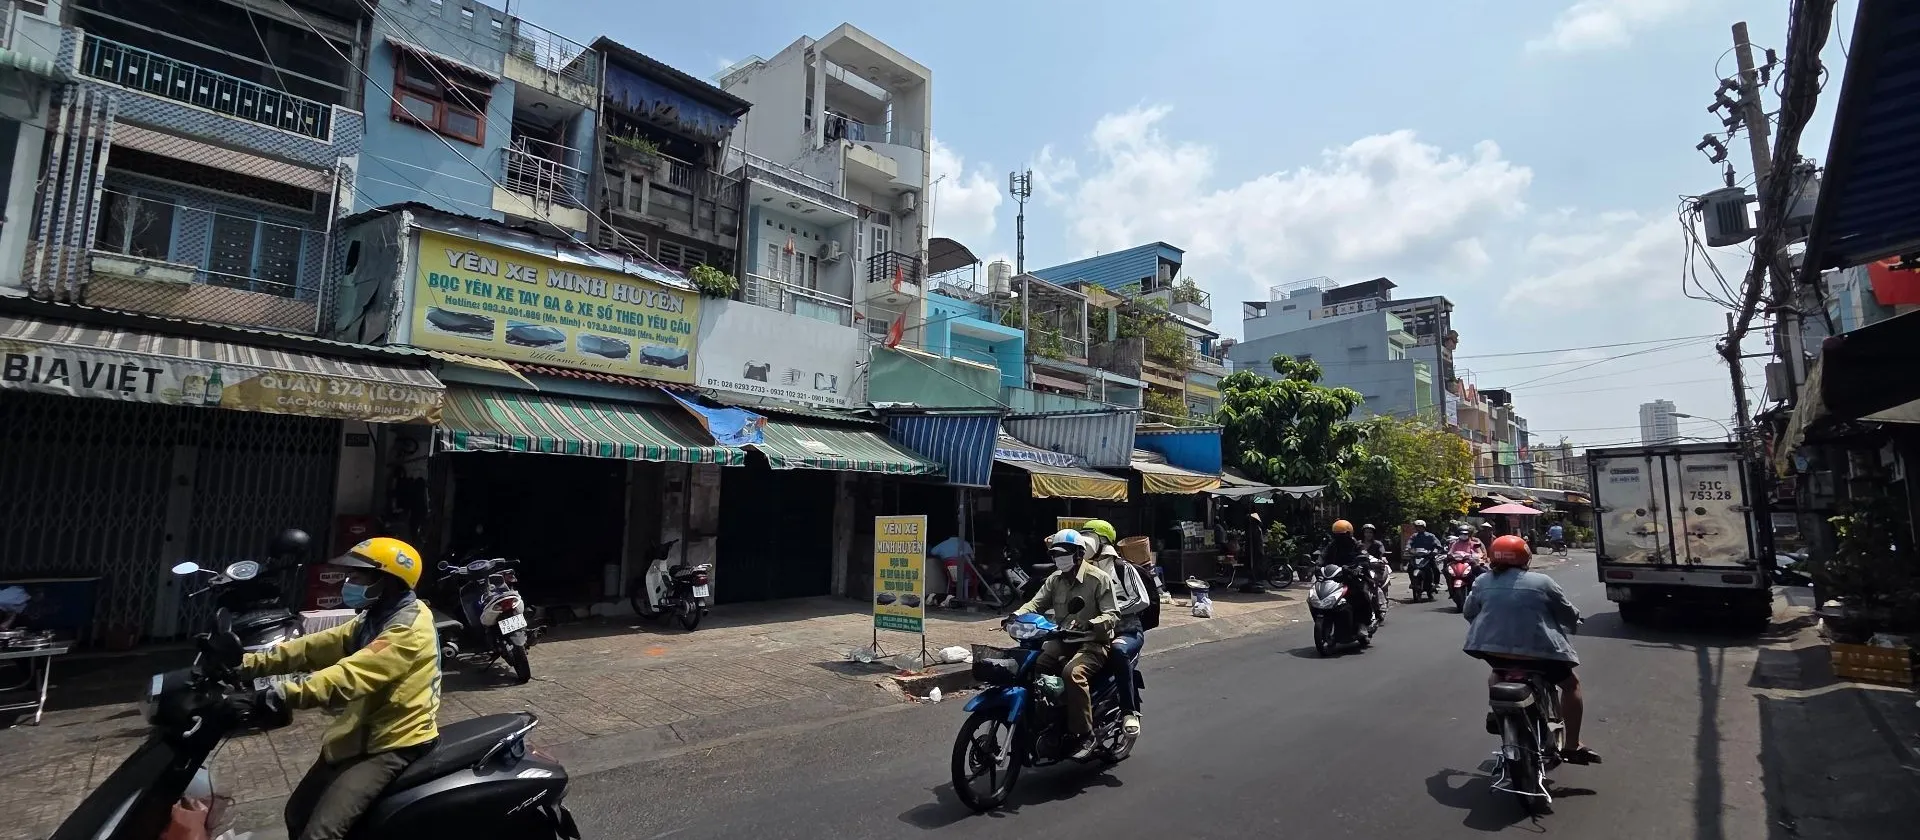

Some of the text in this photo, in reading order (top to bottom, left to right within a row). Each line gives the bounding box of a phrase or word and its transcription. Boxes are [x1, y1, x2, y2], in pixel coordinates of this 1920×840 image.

[445, 249, 498, 276] YÊN
[505, 262, 538, 284] XE
[546, 268, 608, 298] MINH
[428, 272, 460, 293] BỌC
[465, 278, 492, 298] YÊN
[496, 285, 514, 302] XE
[518, 289, 540, 306] TAY
[543, 295, 560, 311] GA
[564, 300, 574, 313] &
[577, 302, 594, 317] XE
[597, 303, 613, 320] SỐ
[616, 309, 644, 326] THEO
[647, 314, 667, 331] YÊU
[445, 295, 480, 309] Hotline:
[560, 315, 580, 328] Minh)
[3, 353, 164, 396] BIA VIỆT
[328, 380, 364, 398] 374
[708, 378, 719, 387] ĐT:
[722, 381, 733, 389] 028
[734, 382, 749, 390] 6293
[750, 385, 765, 393] 2733
[770, 388, 784, 396] 0932
[785, 390, 796, 398] 102
[797, 392, 807, 400] 321
[277, 395, 306, 406] CÁC
[1699, 481, 1722, 490] 51C
[1690, 491, 1732, 500] 753.28
[884, 520, 918, 535] YÊN XE
[877, 541, 895, 553] MINH
